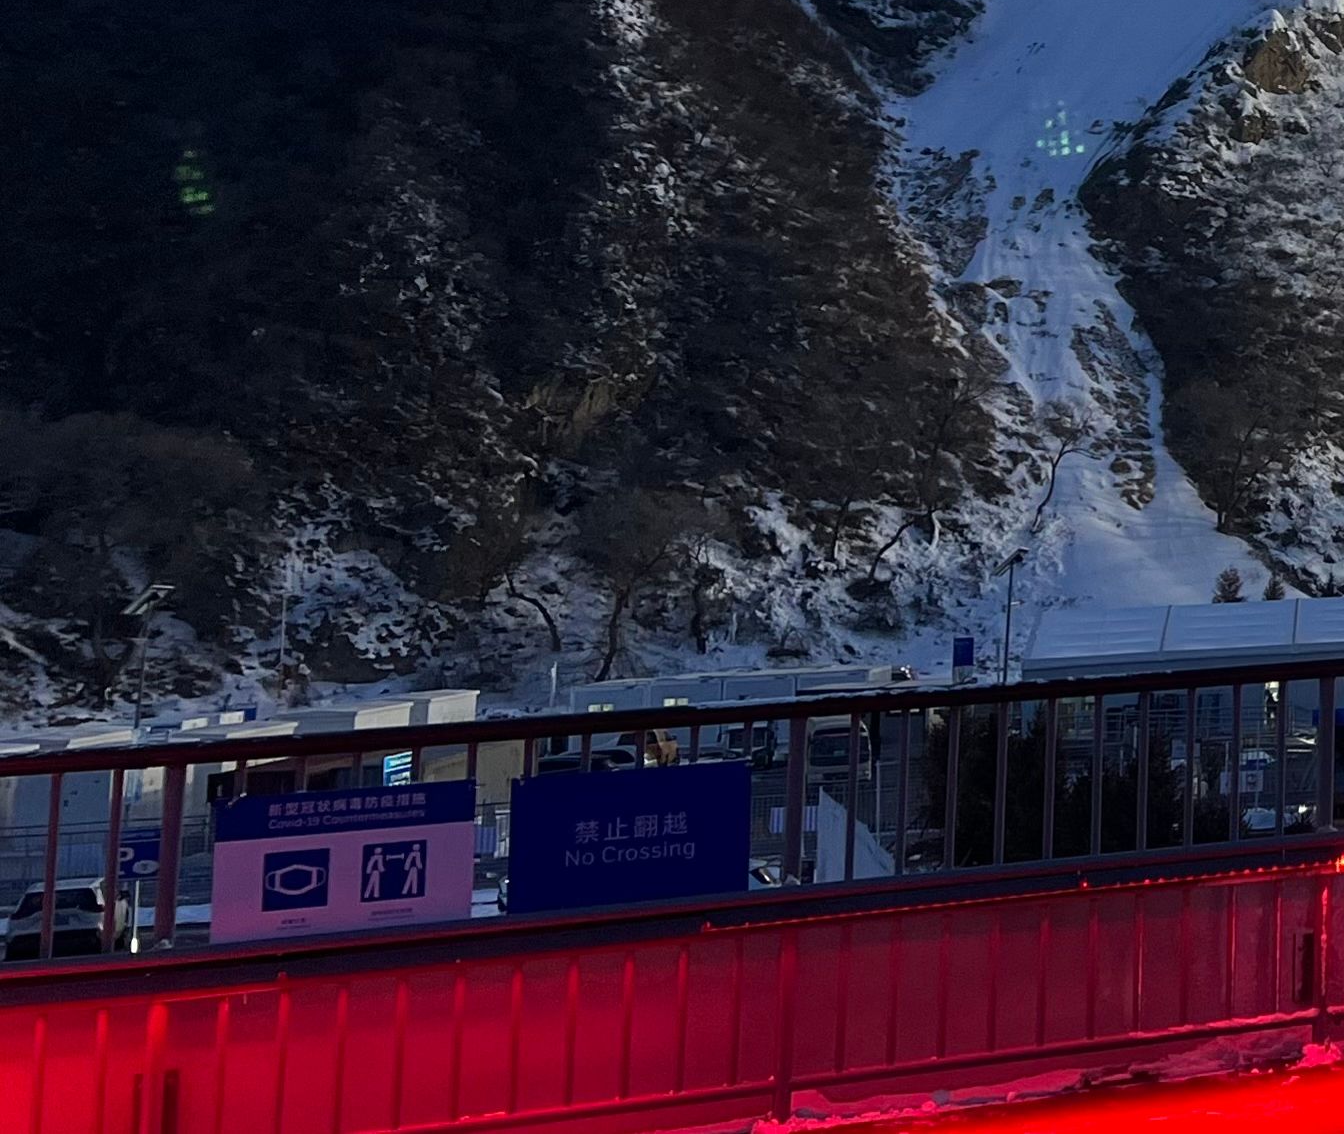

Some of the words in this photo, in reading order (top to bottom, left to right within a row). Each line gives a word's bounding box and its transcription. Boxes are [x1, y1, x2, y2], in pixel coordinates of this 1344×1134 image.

[268, 816, 320, 830] Covid-19
[575, 812, 688, 844] 禁止翻越
[565, 850, 595, 867] No
[602, 841, 696, 864] Crossing
